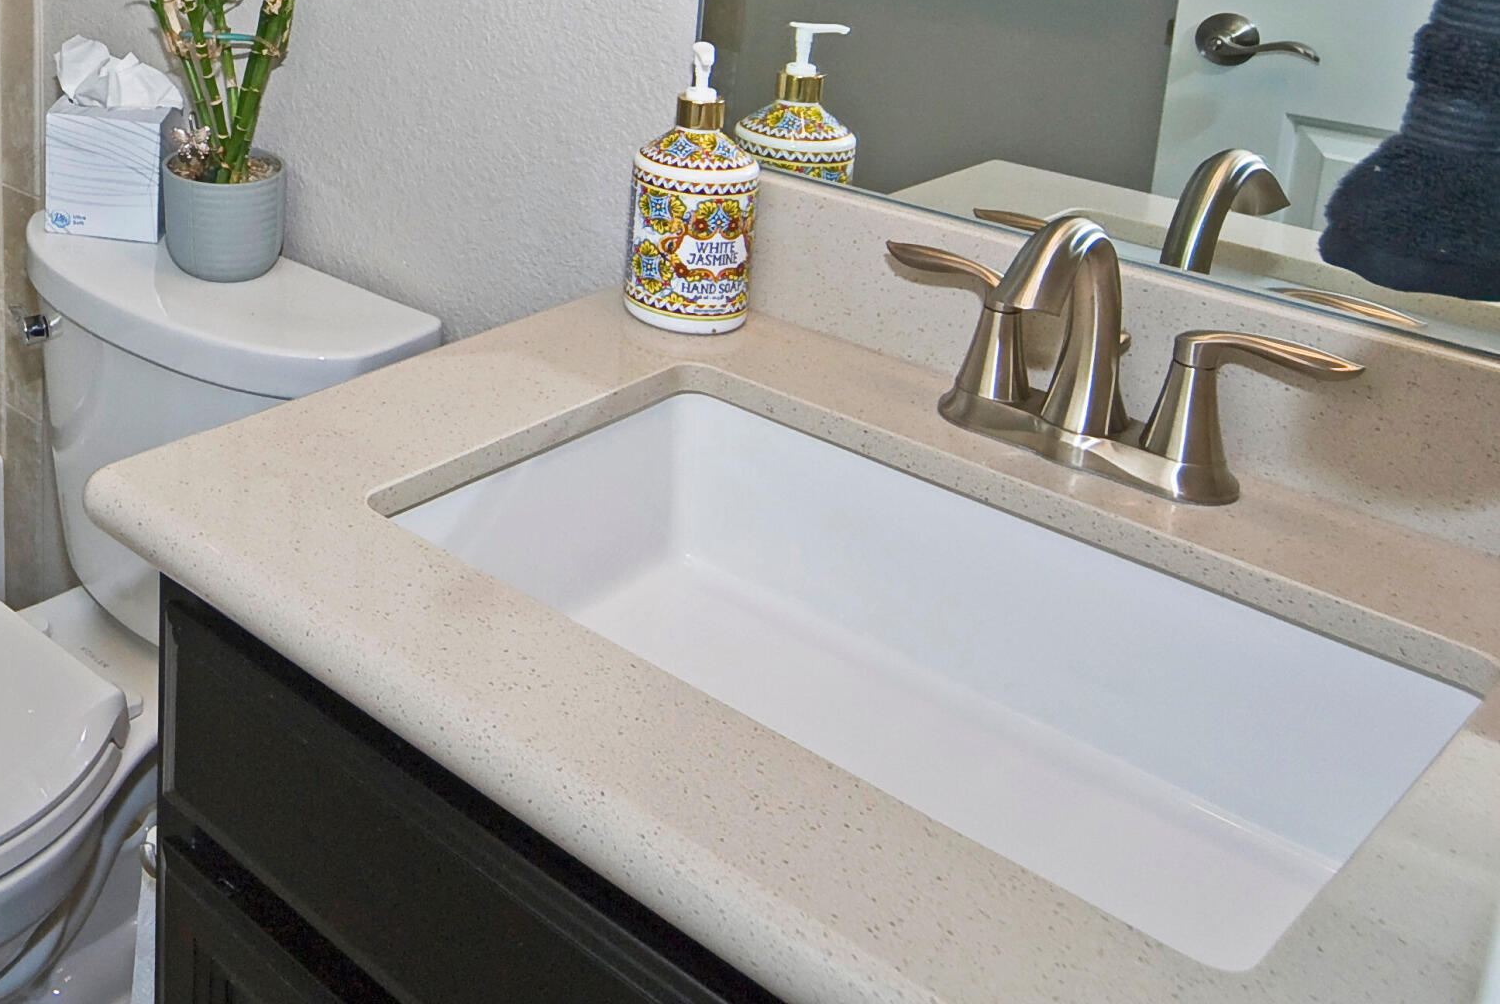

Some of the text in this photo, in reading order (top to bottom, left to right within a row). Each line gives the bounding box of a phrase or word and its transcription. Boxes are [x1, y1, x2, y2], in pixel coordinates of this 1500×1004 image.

[695, 241, 736, 254] WHITE
[686, 252, 739, 267] JASMINE
[681, 280, 742, 294] HAND SOAP
